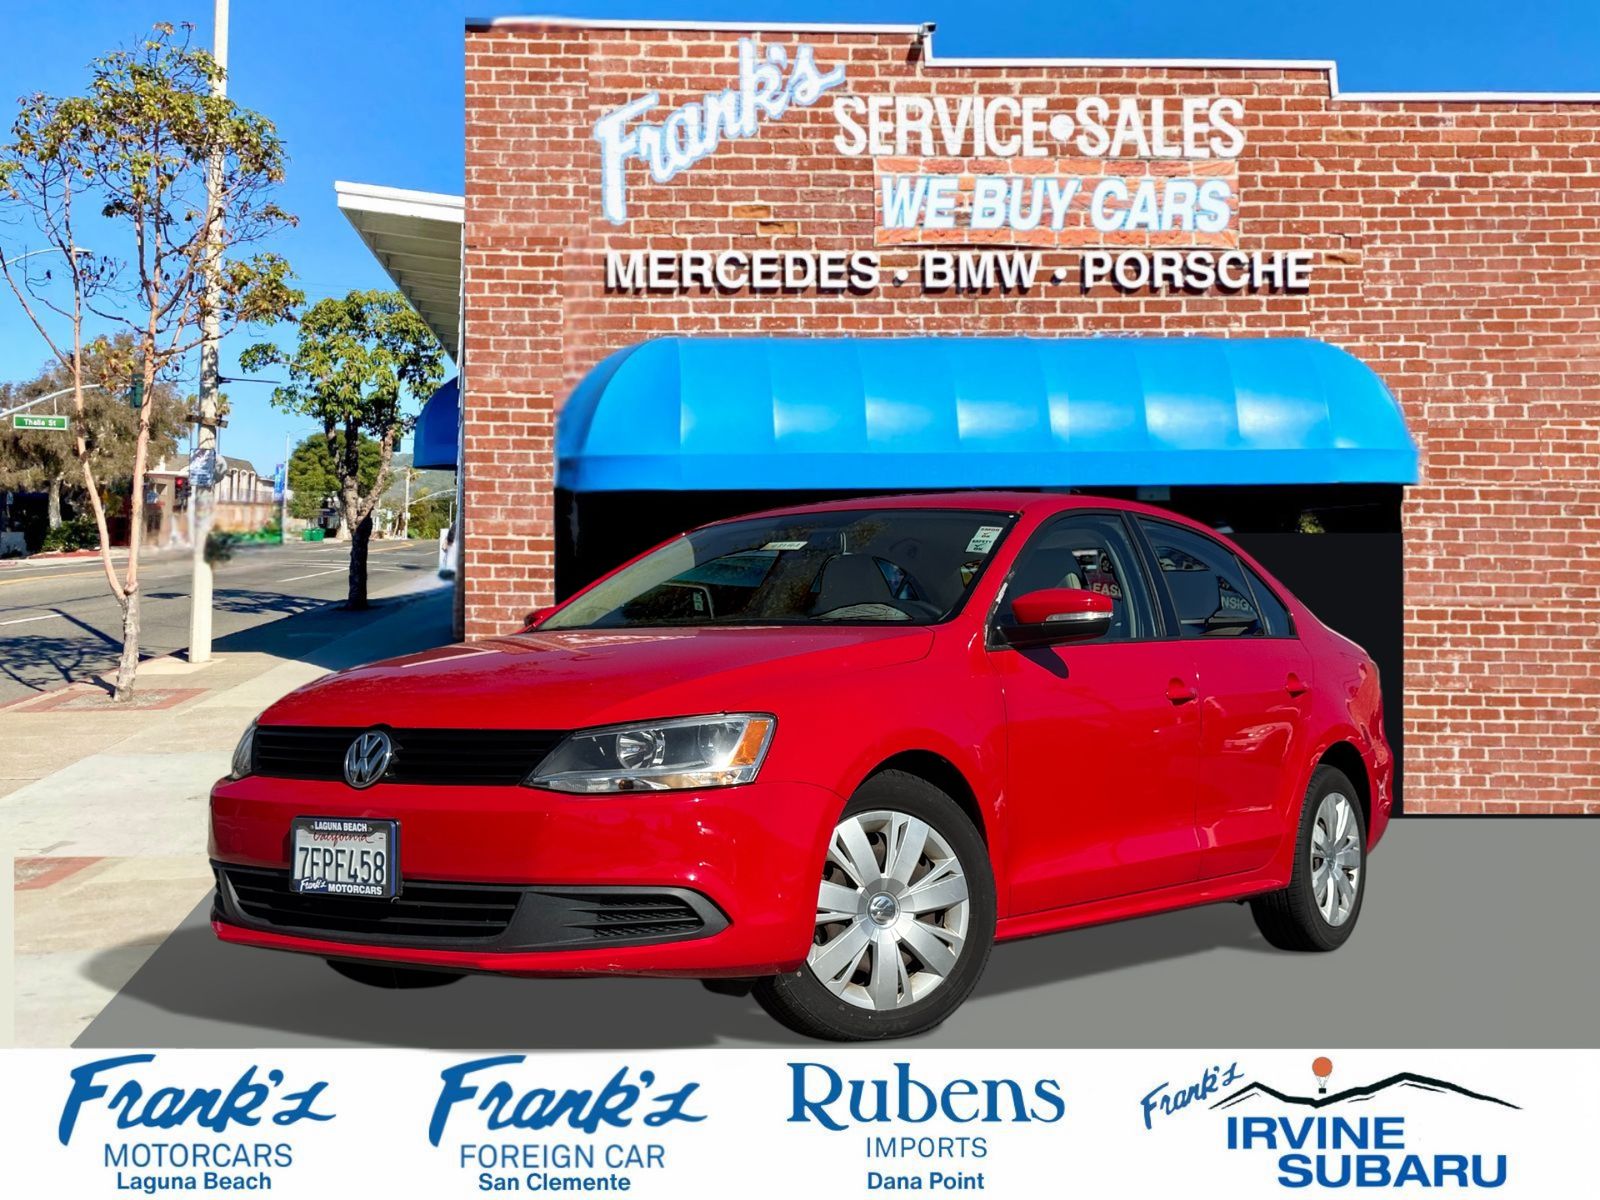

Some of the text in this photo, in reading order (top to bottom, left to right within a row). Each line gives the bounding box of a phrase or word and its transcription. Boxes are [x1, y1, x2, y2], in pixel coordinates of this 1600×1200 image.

[594, 37, 846, 226] Frank's
[881, 176, 1232, 232] WE BUY CARS
[605, 249, 1313, 293] MERCEDES BMW PORSCHE
[1092, 582, 1122, 597] EAS
[314, 821, 368, 832] LAGUNA BEACH
[299, 846, 386, 885] 7FPF458
[328, 883, 383, 896] MOTORCARS
